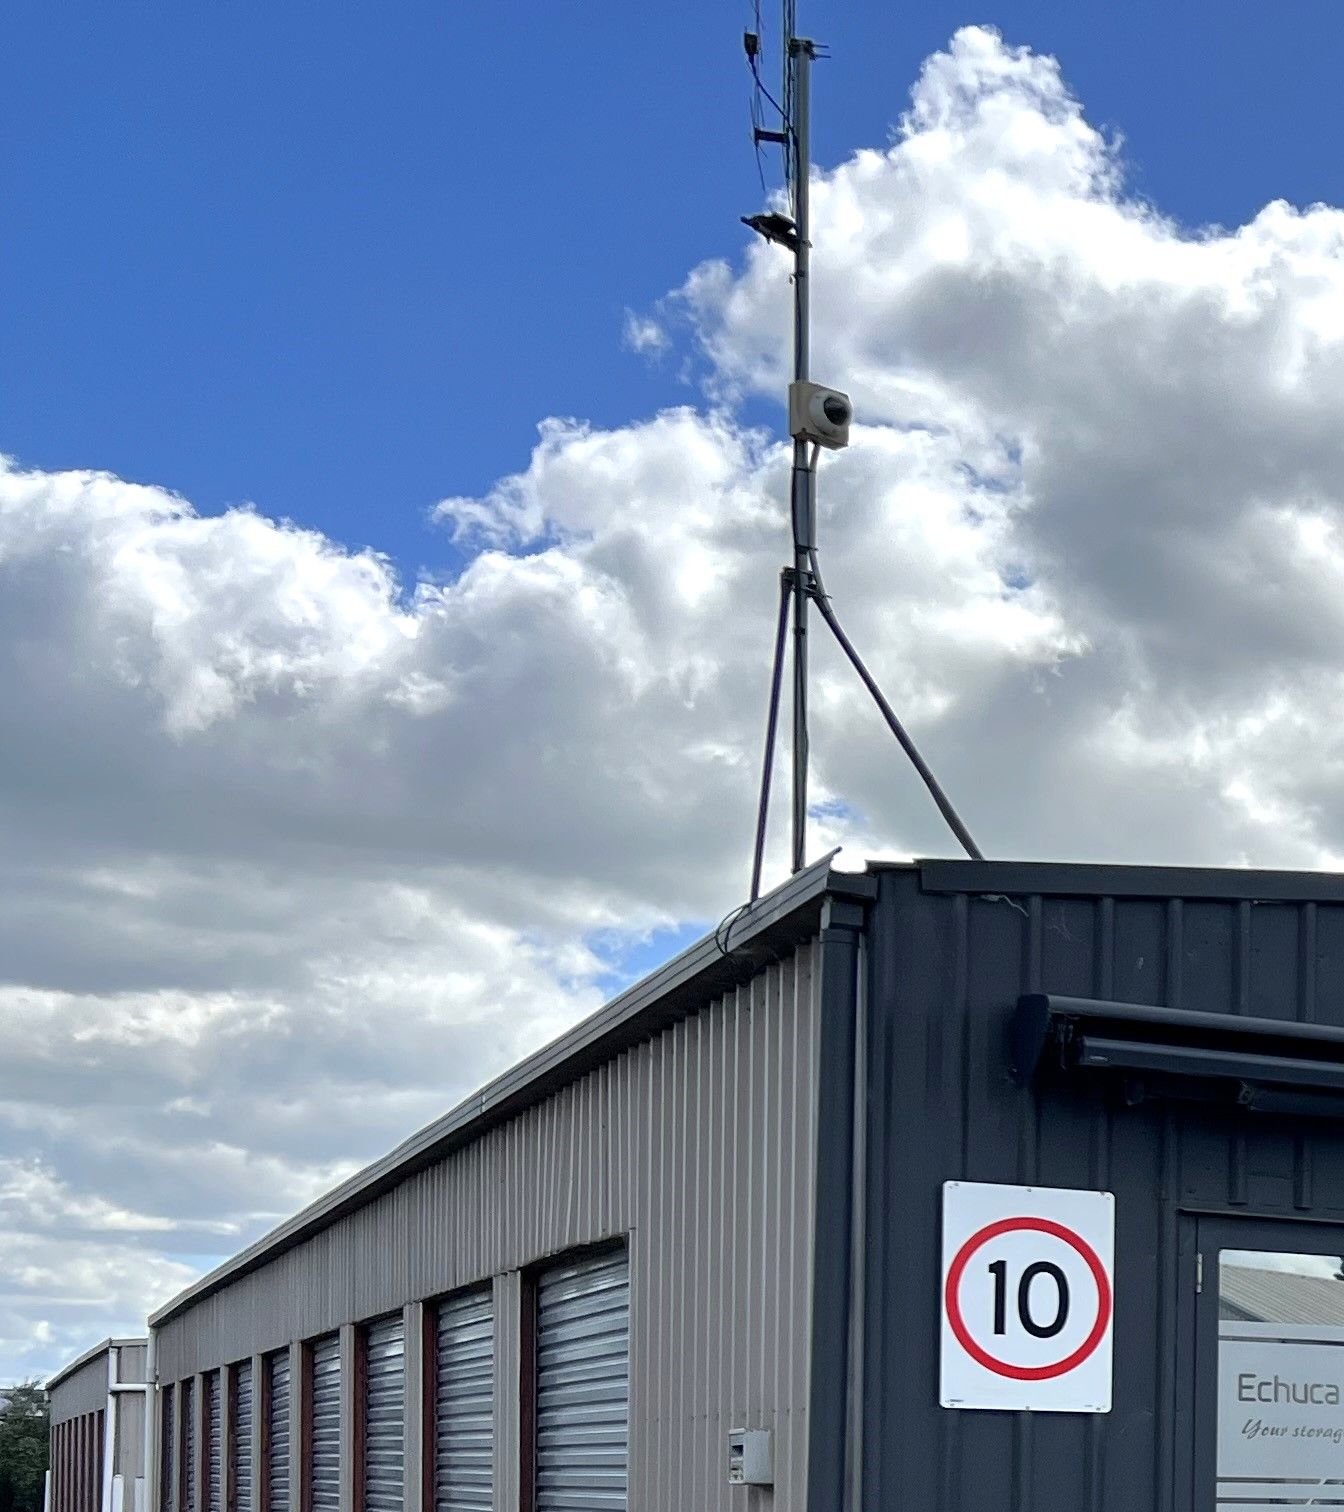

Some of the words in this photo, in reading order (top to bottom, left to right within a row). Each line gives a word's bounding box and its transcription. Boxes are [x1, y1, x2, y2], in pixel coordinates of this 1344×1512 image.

[988, 1259, 1071, 1339] 10
[1237, 1372, 1340, 1405] Echuca
[1241, 1418, 1288, 1440] Your
